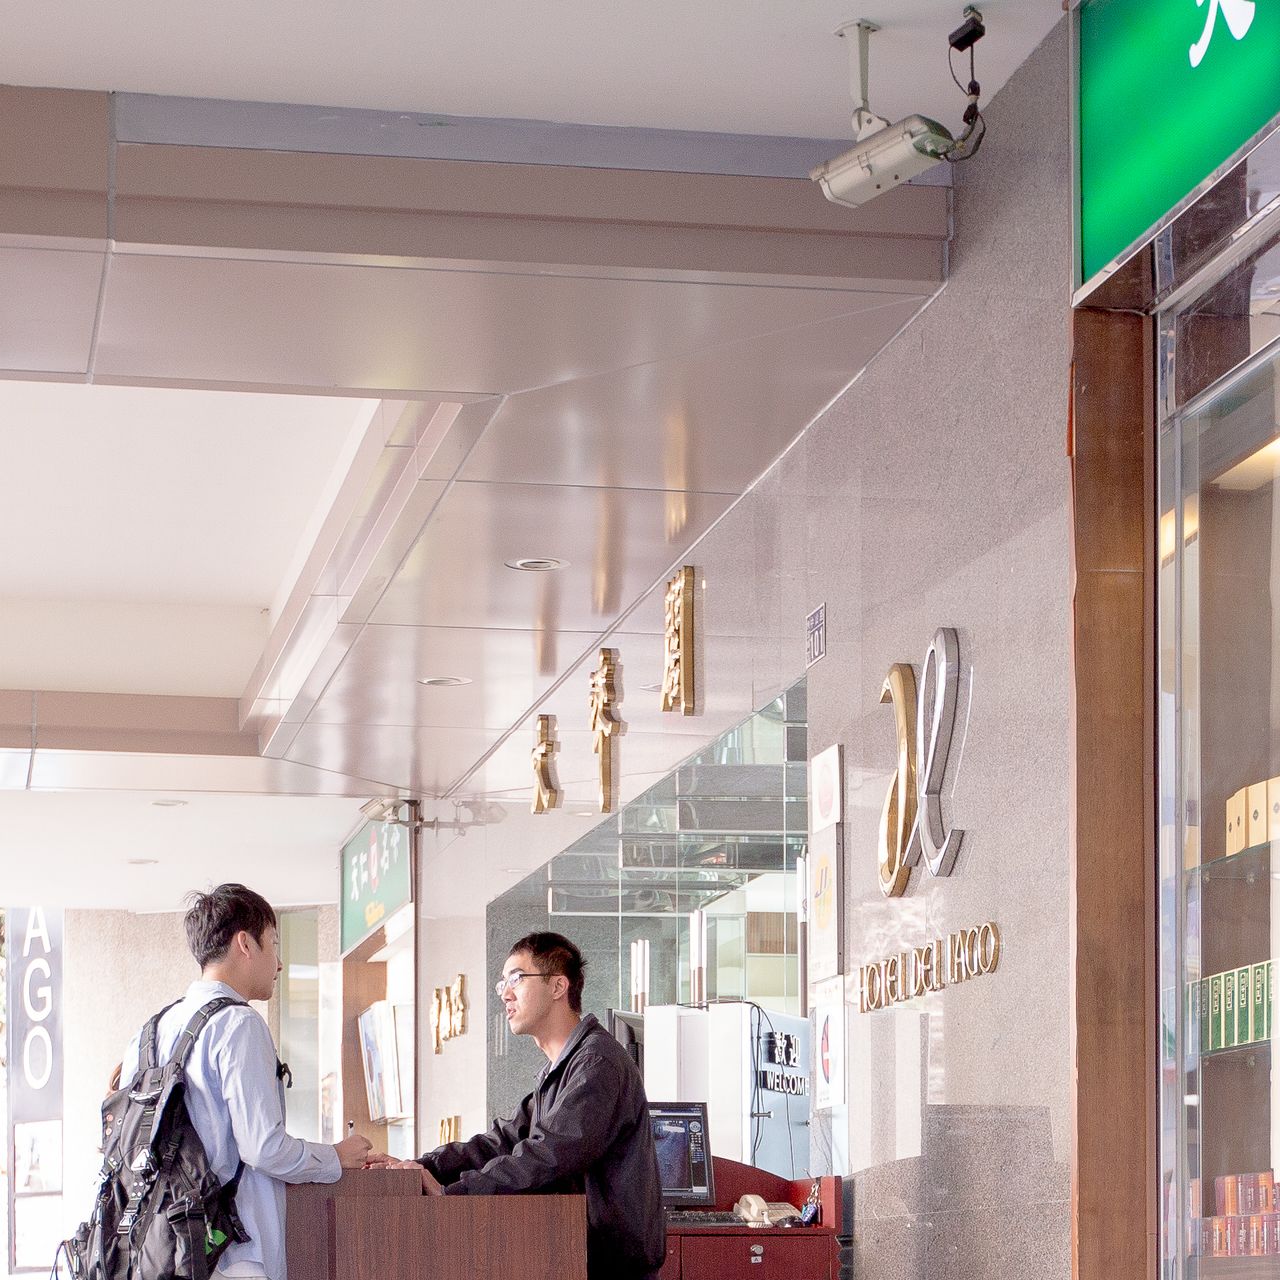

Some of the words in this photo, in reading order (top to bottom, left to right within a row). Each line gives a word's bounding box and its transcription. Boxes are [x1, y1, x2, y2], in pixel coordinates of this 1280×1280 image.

[22, 906, 53, 1090] AGO
[858, 952, 909, 1013] HOTEL
[912, 940, 945, 997] DEL
[947, 921, 1000, 984] LAGO
[766, 1070, 809, 1097] WELCOME
